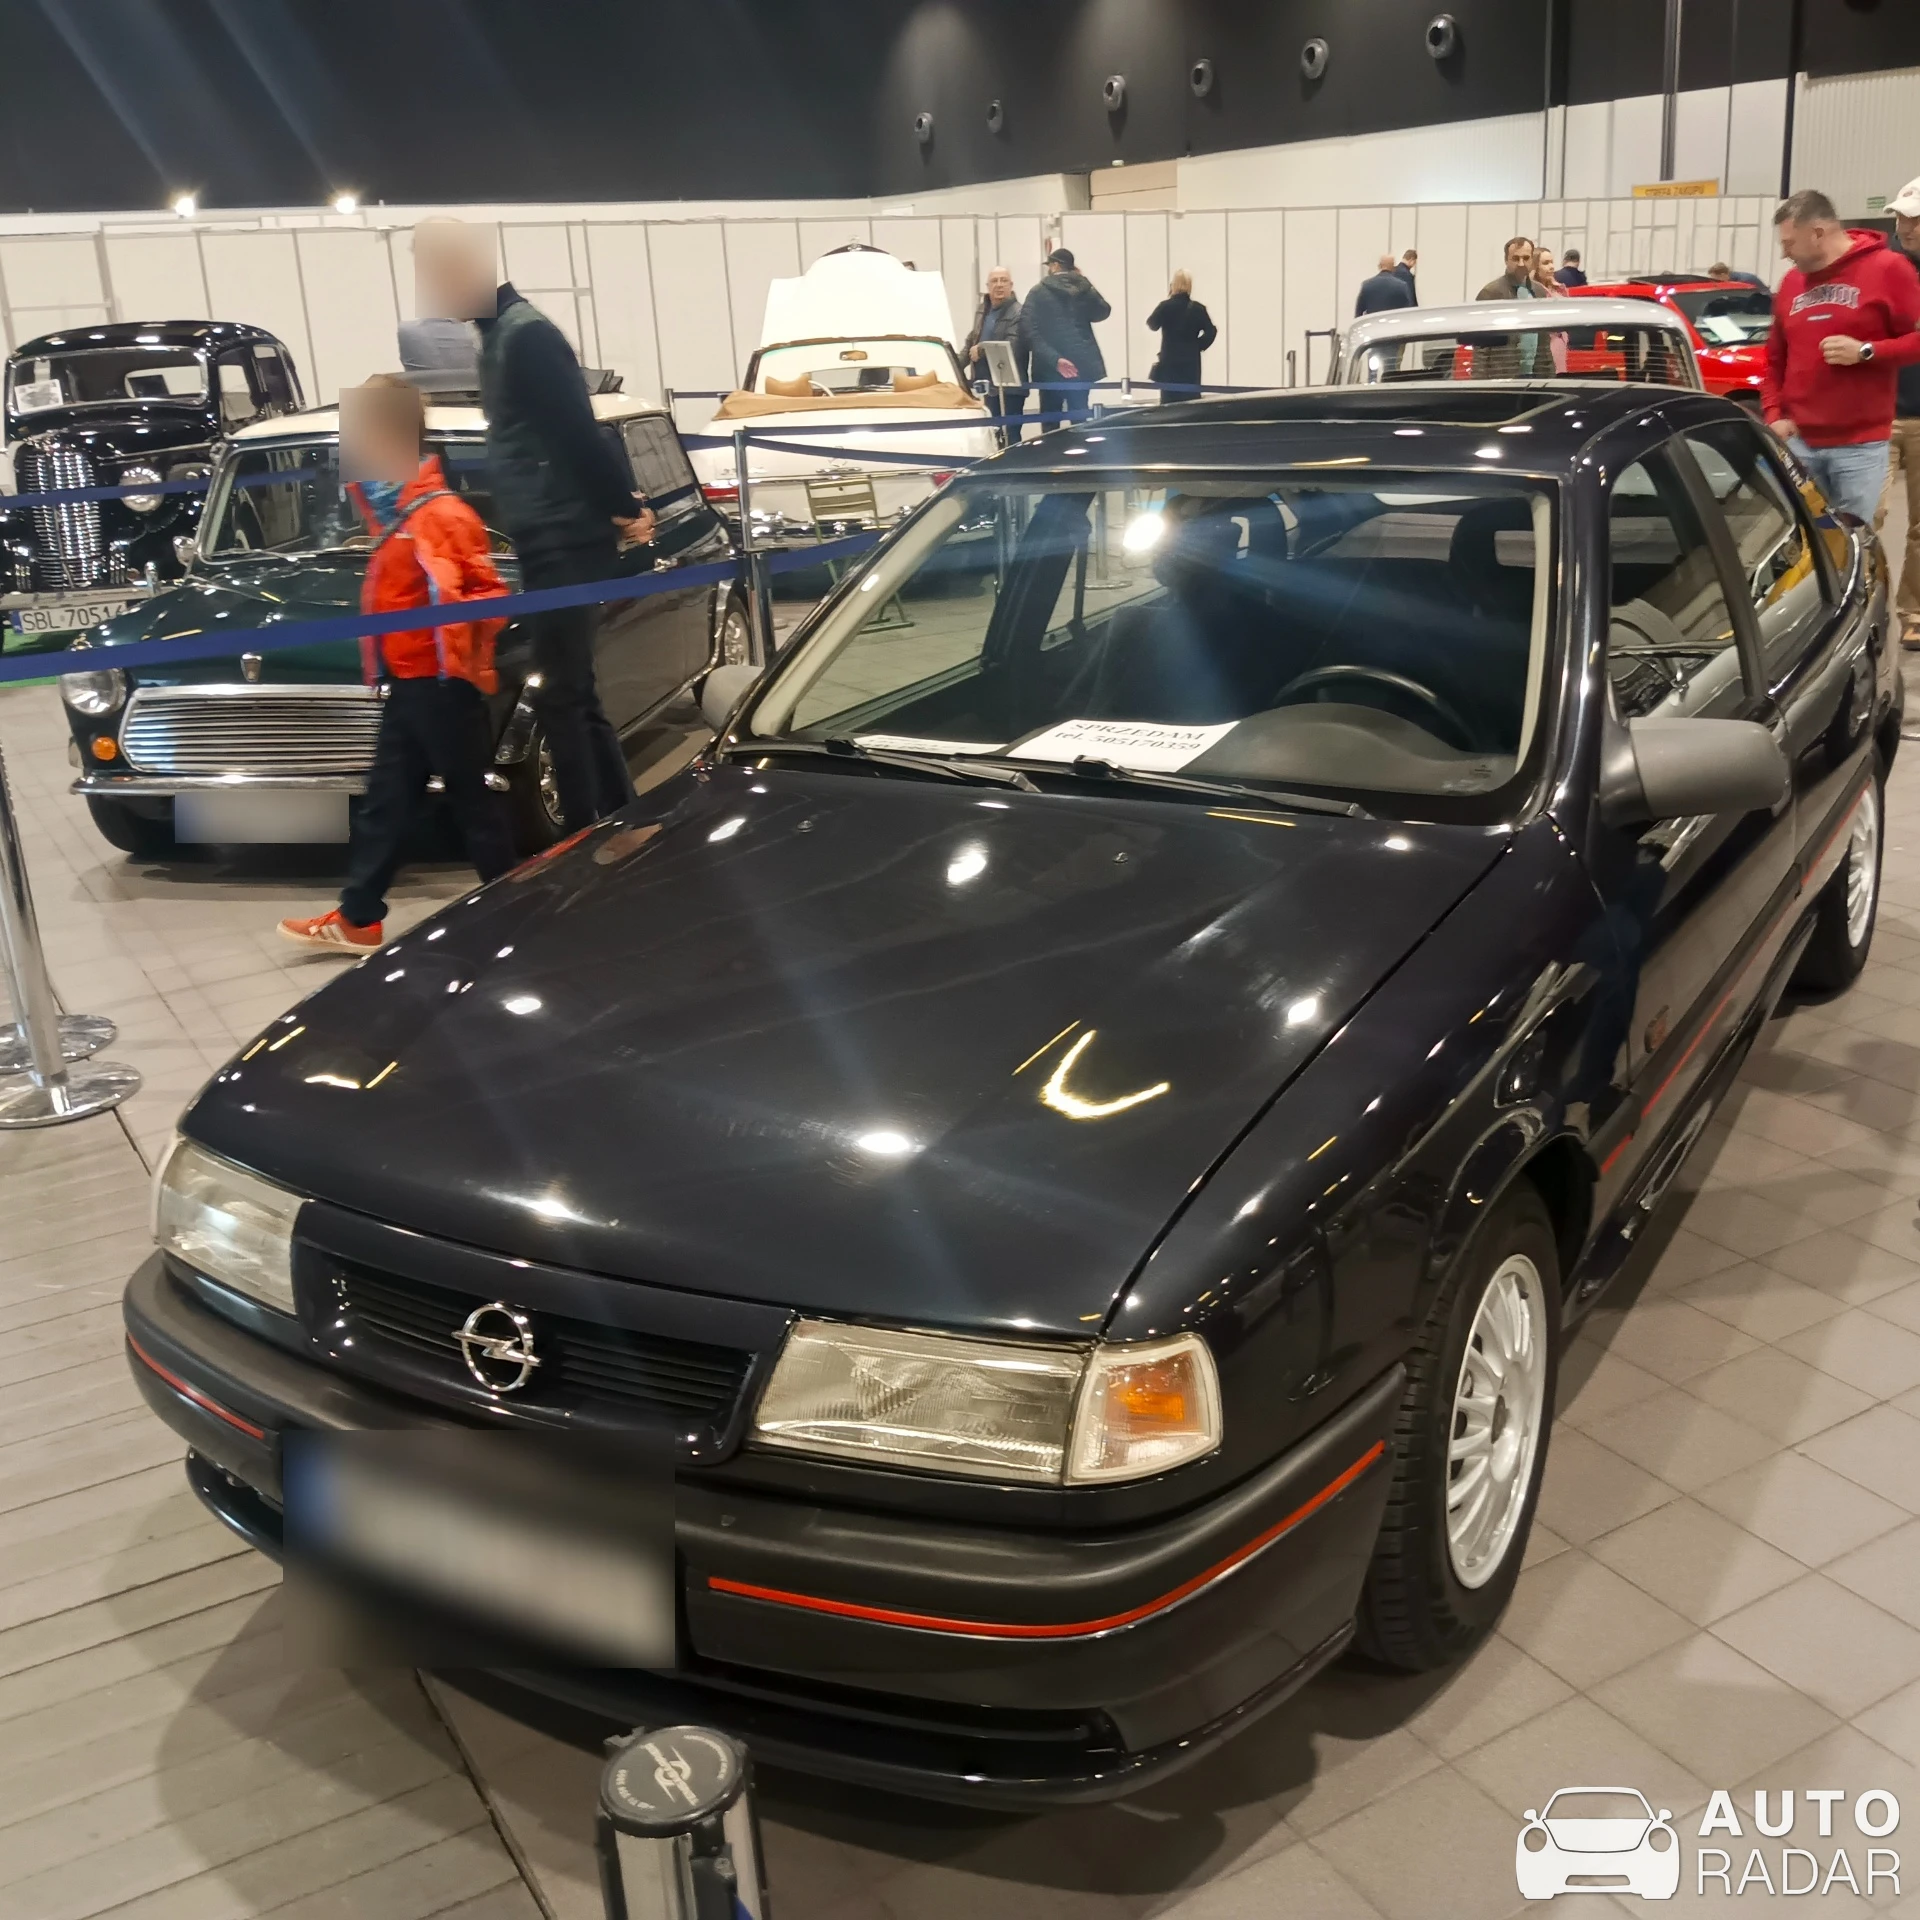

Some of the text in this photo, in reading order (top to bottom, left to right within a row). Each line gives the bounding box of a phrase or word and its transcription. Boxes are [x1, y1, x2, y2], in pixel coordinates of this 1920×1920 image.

[22, 611, 61, 631] SBL
[1055, 732, 1083, 741] tel.
[1071, 723, 1206, 741] SPRZEDAM
